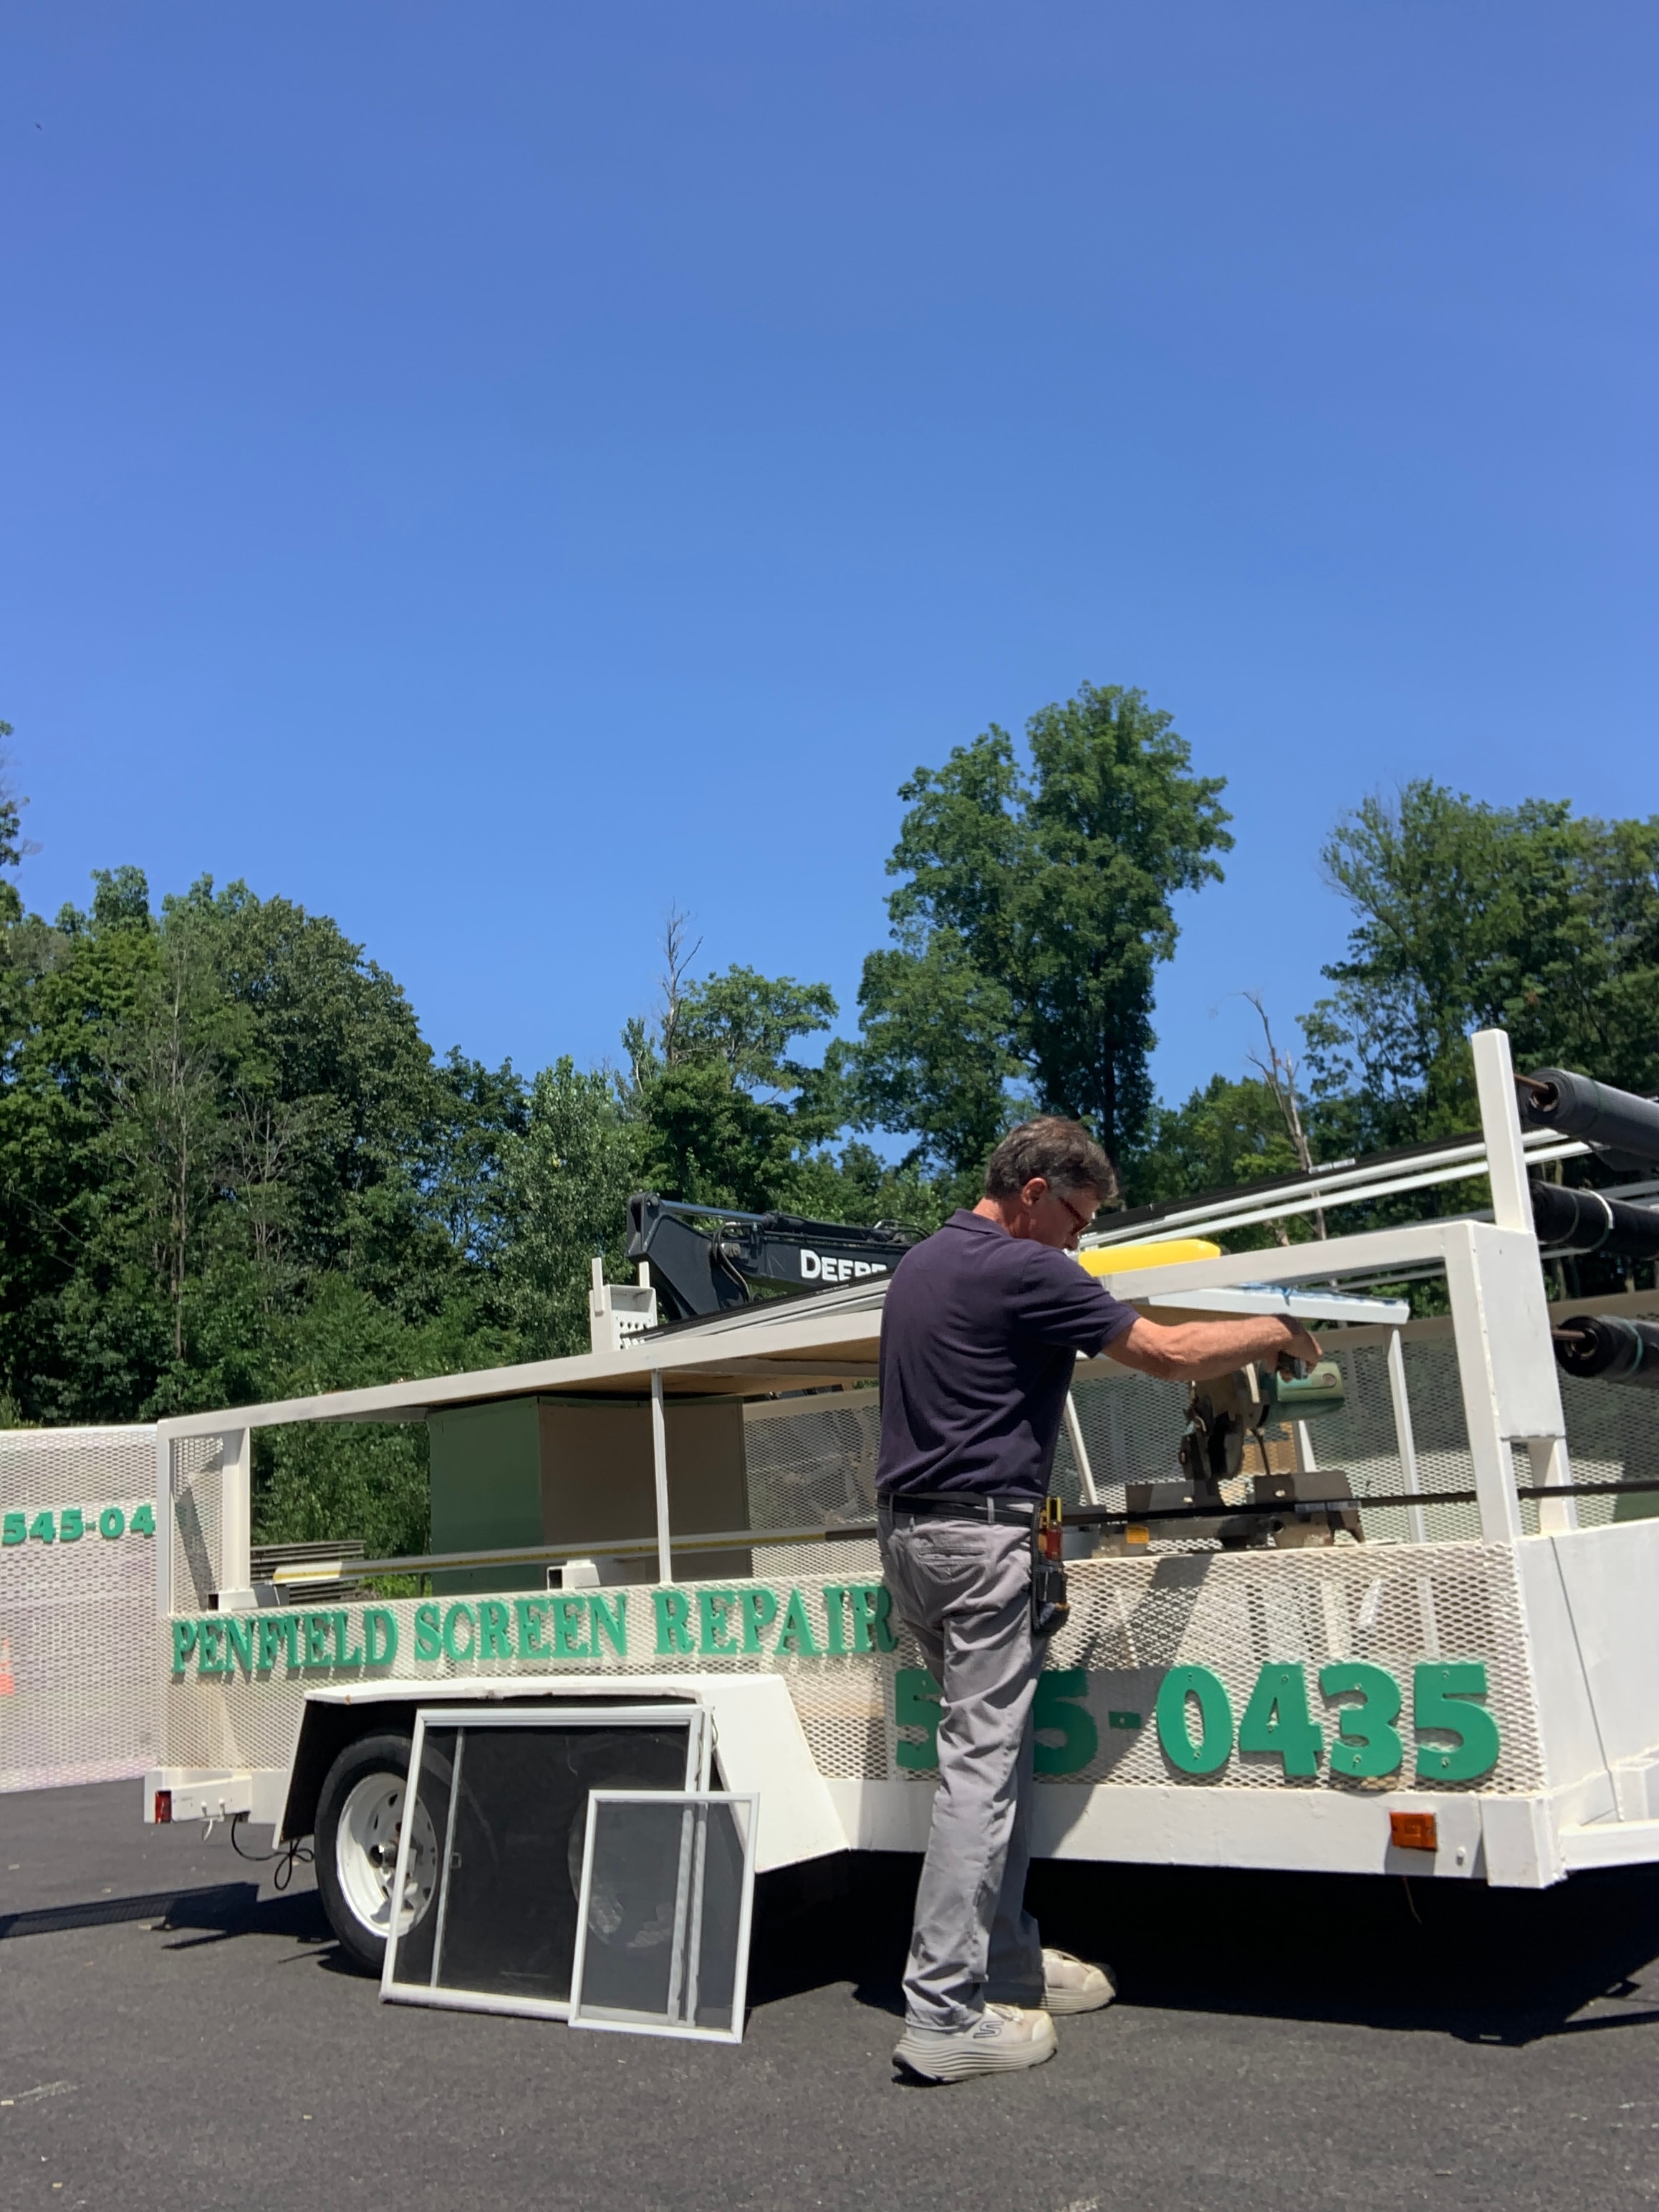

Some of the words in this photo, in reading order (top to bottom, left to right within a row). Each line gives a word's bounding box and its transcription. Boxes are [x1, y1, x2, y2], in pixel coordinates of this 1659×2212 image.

[172, 1609, 398, 1673] PENFIELD
[414, 1593, 627, 1662] SCREEN
[651, 1585, 899, 1655] REPAIR
[895, 1661, 1500, 1781] 55-0435
